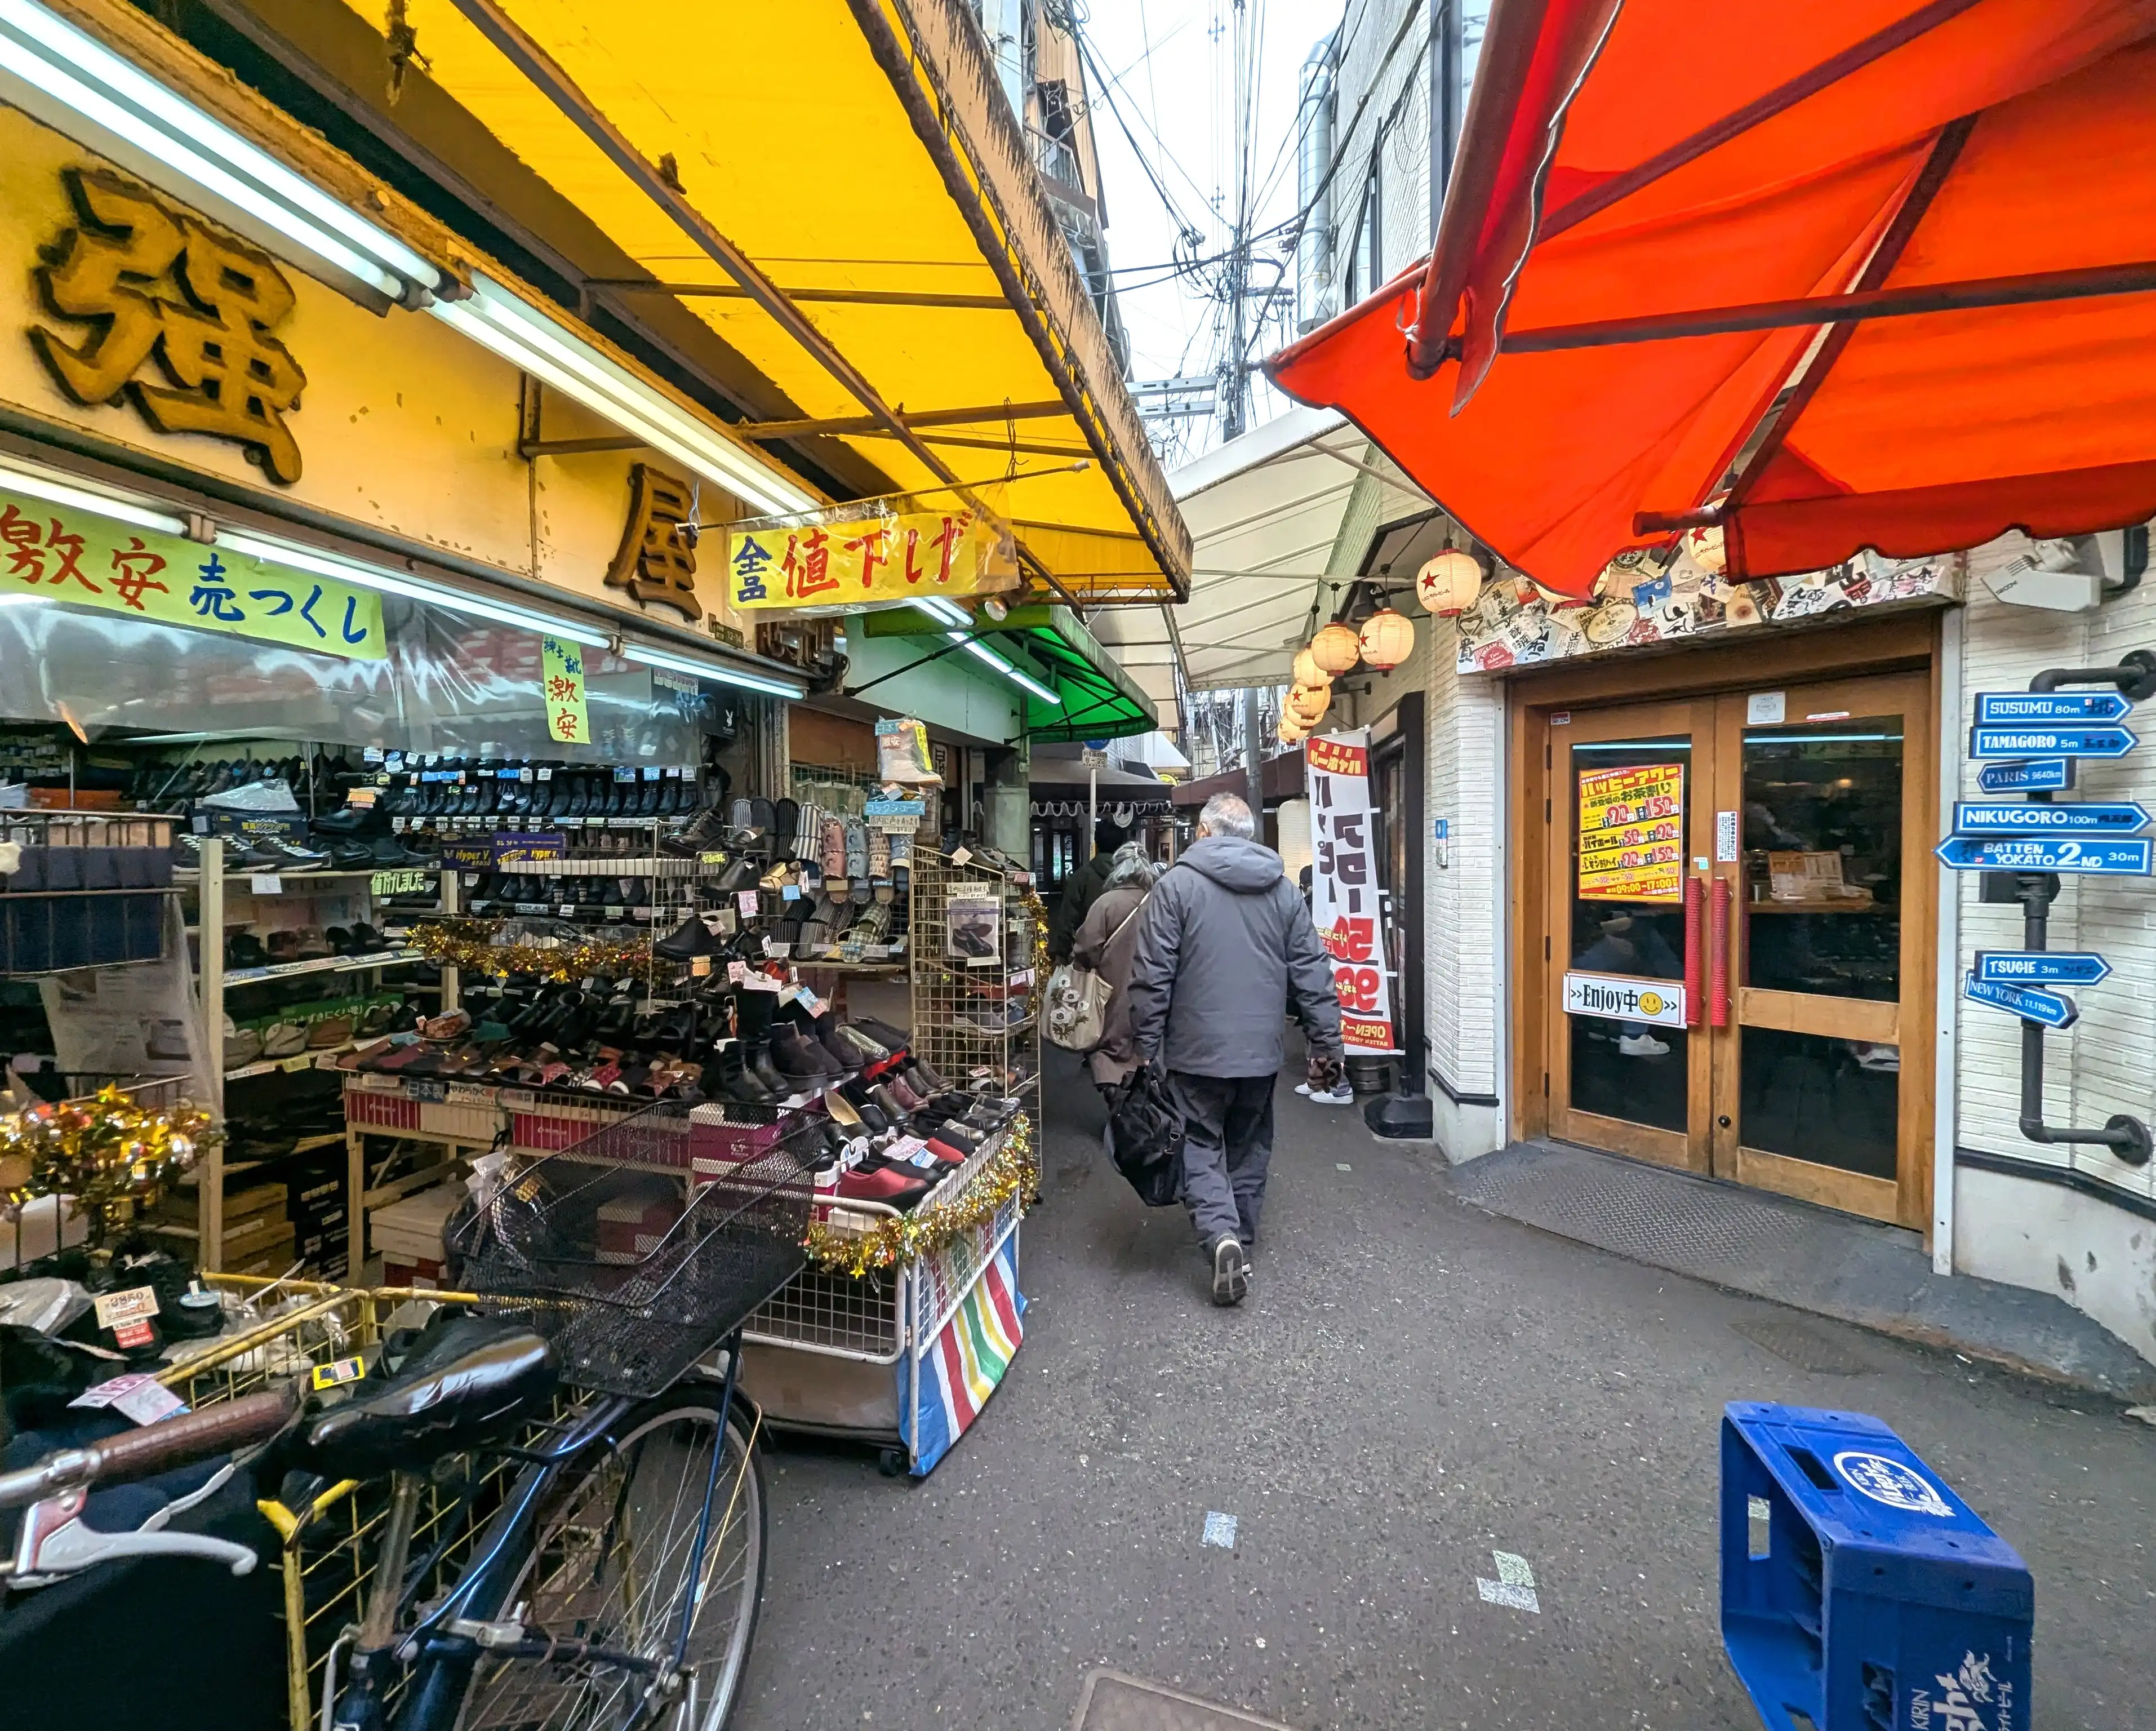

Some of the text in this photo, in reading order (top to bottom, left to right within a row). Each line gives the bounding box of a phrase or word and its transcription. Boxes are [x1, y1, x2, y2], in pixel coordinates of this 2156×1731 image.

[604, 462, 703, 622] 屋
[732, 512, 974, 602] 全品 値下げ
[189, 552, 368, 645] 売つくし
[548, 676, 579, 739] 激安
[1990, 702, 2052, 714] SUSUMU
[2055, 705, 2080, 714] 80m
[1983, 735, 2056, 749] TAMAGORO
[2060, 739, 2078, 748] 5m
[1581, 767, 1678, 797] ハッピーアワー
[1986, 770, 2029, 784] PARIS
[1966, 810, 2067, 824] NIKUGORO
[2069, 815, 2098, 825] 100m
[1983, 842, 2044, 854] BATTEN
[1995, 854, 2056, 866] YOKATO
[2108, 852, 2139, 862] 30m
[1989, 960, 2037, 974] TSUGIE
[2041, 965, 2059, 974] 3m
[1582, 984, 1638, 1014] Enjoy中
[1969, 980, 1994, 996] NEW
[1995, 987, 2024, 1006] YORK
[1911, 1688, 1931, 1731] KIRIN
